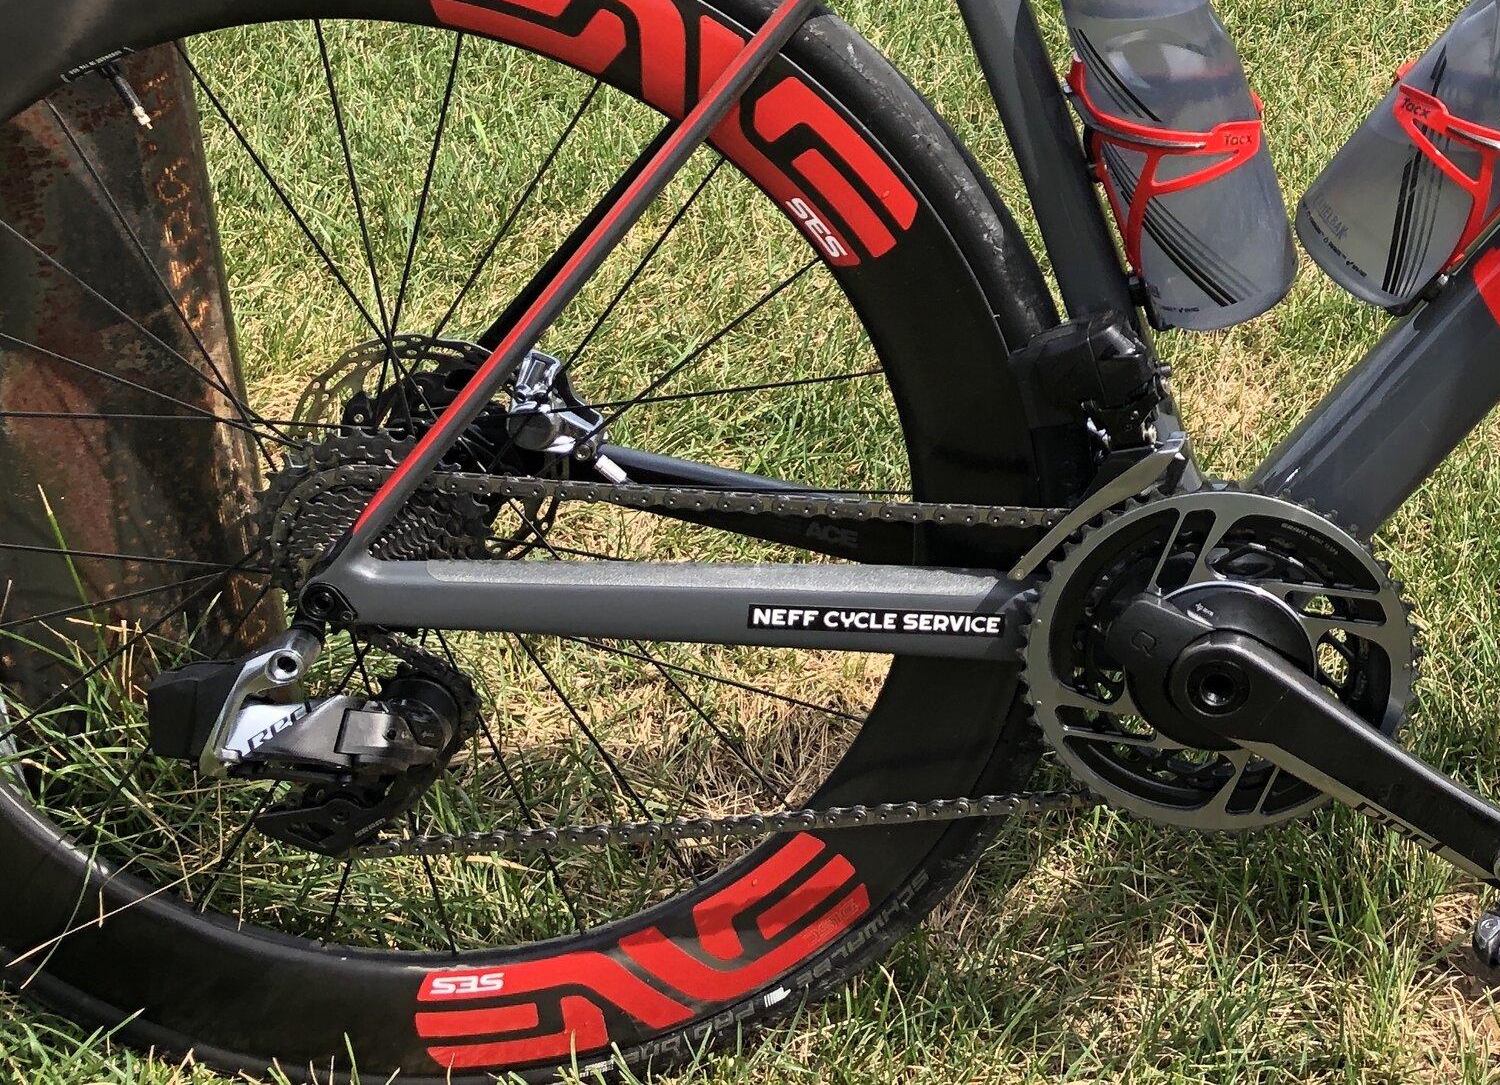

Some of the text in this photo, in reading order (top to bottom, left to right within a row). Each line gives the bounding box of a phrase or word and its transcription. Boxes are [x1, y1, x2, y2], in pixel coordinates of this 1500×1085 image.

[1401, 97, 1431, 119] Tacx
[1224, 134, 1252, 146] Tacx
[784, 196, 849, 259] SES
[753, 608, 1002, 635] NEFF CYCLE SERVICE
[415, 831, 870, 1069] ENVE
[430, 971, 505, 996] SES
